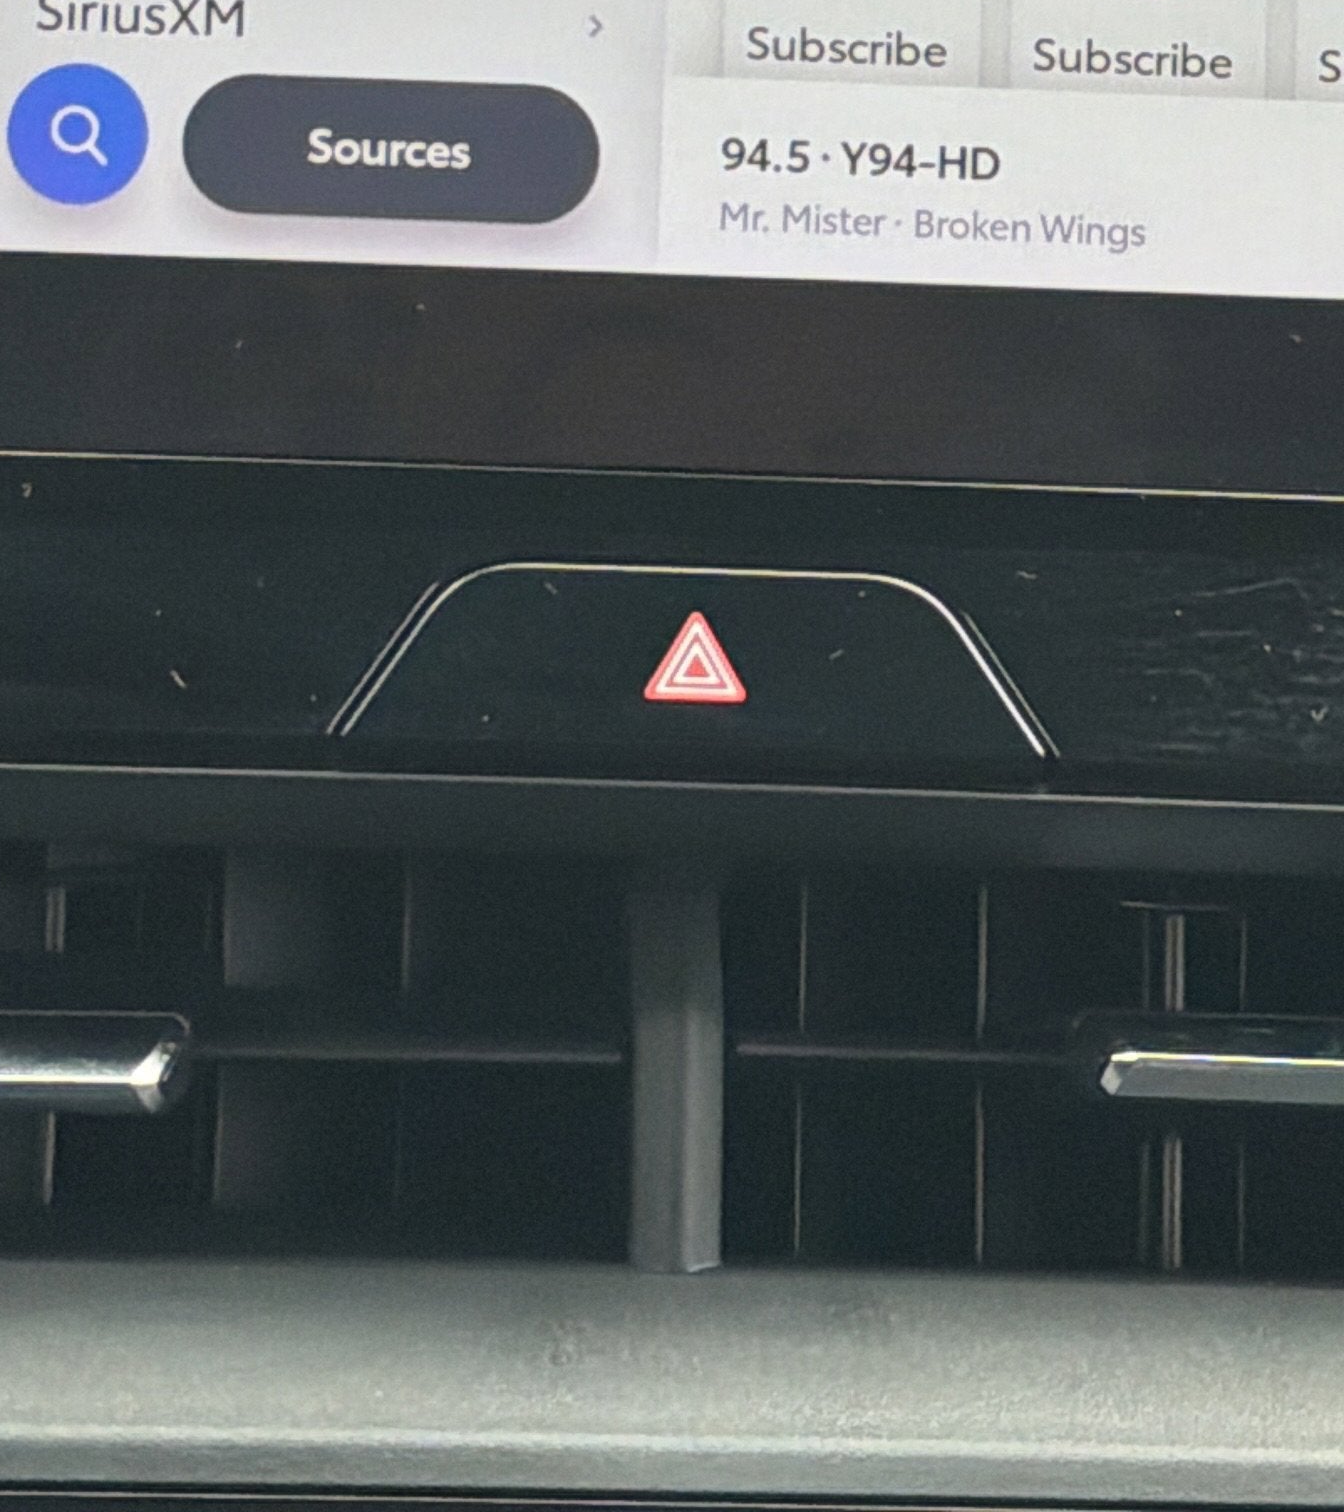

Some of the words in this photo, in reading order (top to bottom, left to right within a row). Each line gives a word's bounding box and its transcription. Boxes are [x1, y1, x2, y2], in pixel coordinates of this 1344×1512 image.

[747, 26, 947, 68] Subscribe
[1033, 38, 1233, 79] Subscribe
[307, 127, 471, 170] Sources
[721, 137, 810, 174] 94.5
[841, 141, 1001, 181] Y94-HD
[719, 201, 769, 233] Mr.
[782, 203, 887, 237] Mister
[914, 209, 1031, 243] Broken
[1040, 213, 1146, 255] Wings
